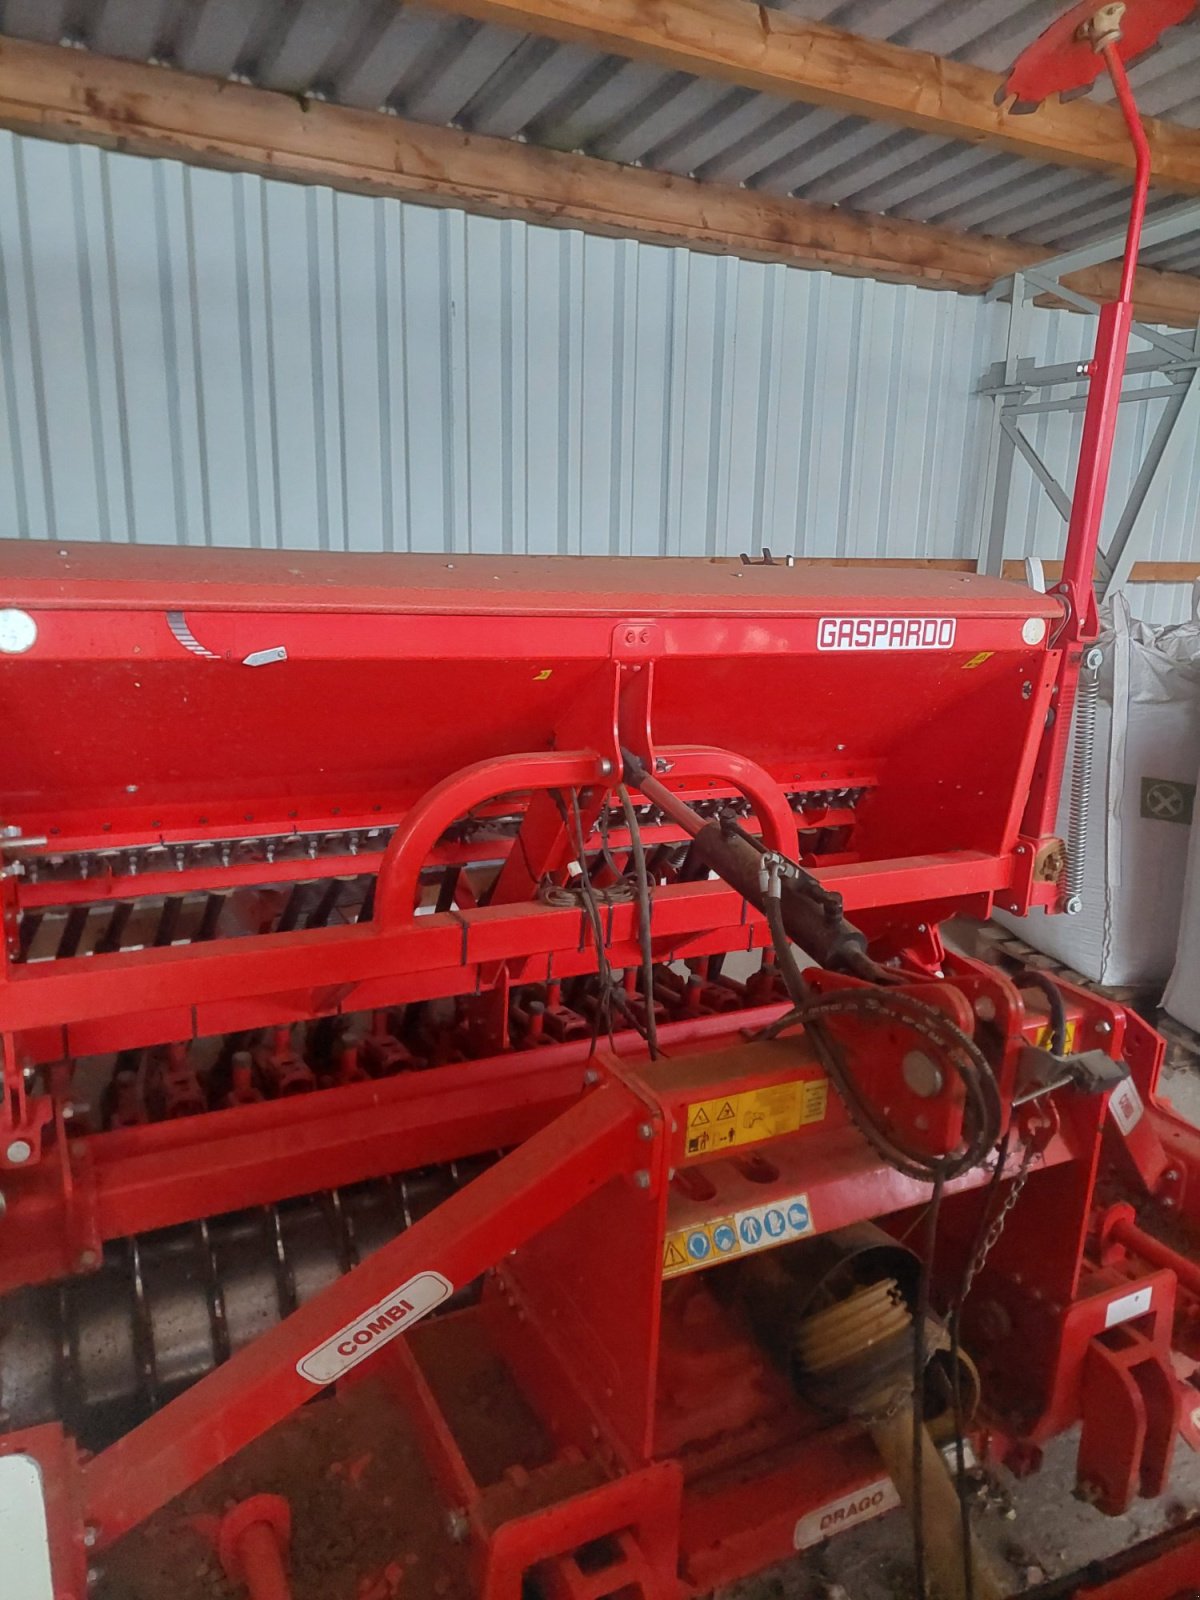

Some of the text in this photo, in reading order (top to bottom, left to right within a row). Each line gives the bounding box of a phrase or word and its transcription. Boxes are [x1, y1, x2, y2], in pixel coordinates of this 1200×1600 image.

[820, 620, 954, 647] GASPARDO
[337, 1299, 415, 1356] COMBI
[820, 1491, 884, 1531] DRAGO
